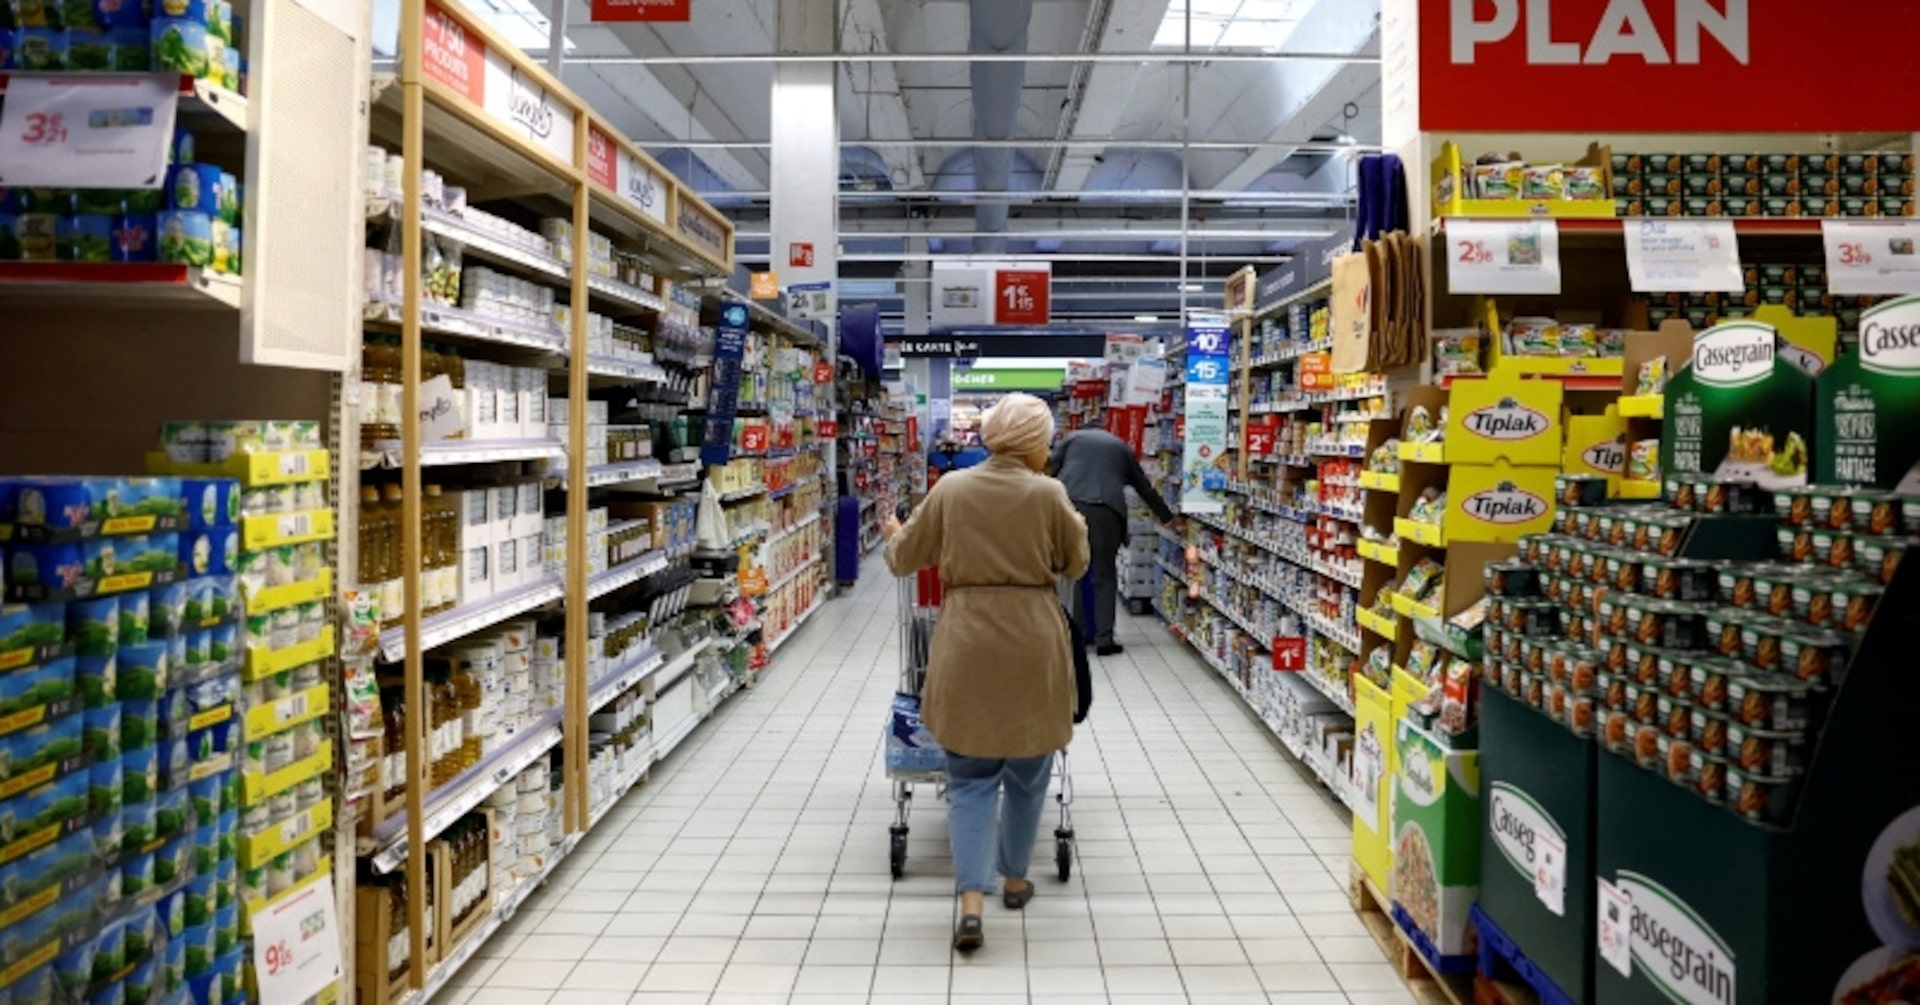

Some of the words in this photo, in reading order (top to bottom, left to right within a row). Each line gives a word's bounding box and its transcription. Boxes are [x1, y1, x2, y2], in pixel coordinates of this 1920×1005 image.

[1451, 0, 1749, 65] PLAN
[1696, 336, 1773, 371] Cassegrain
[1863, 321, 1920, 357] Casse
[1473, 413, 1538, 435] Tipiak
[1473, 497, 1537, 518] Tipiak
[1621, 888, 1731, 1005] assegrain
